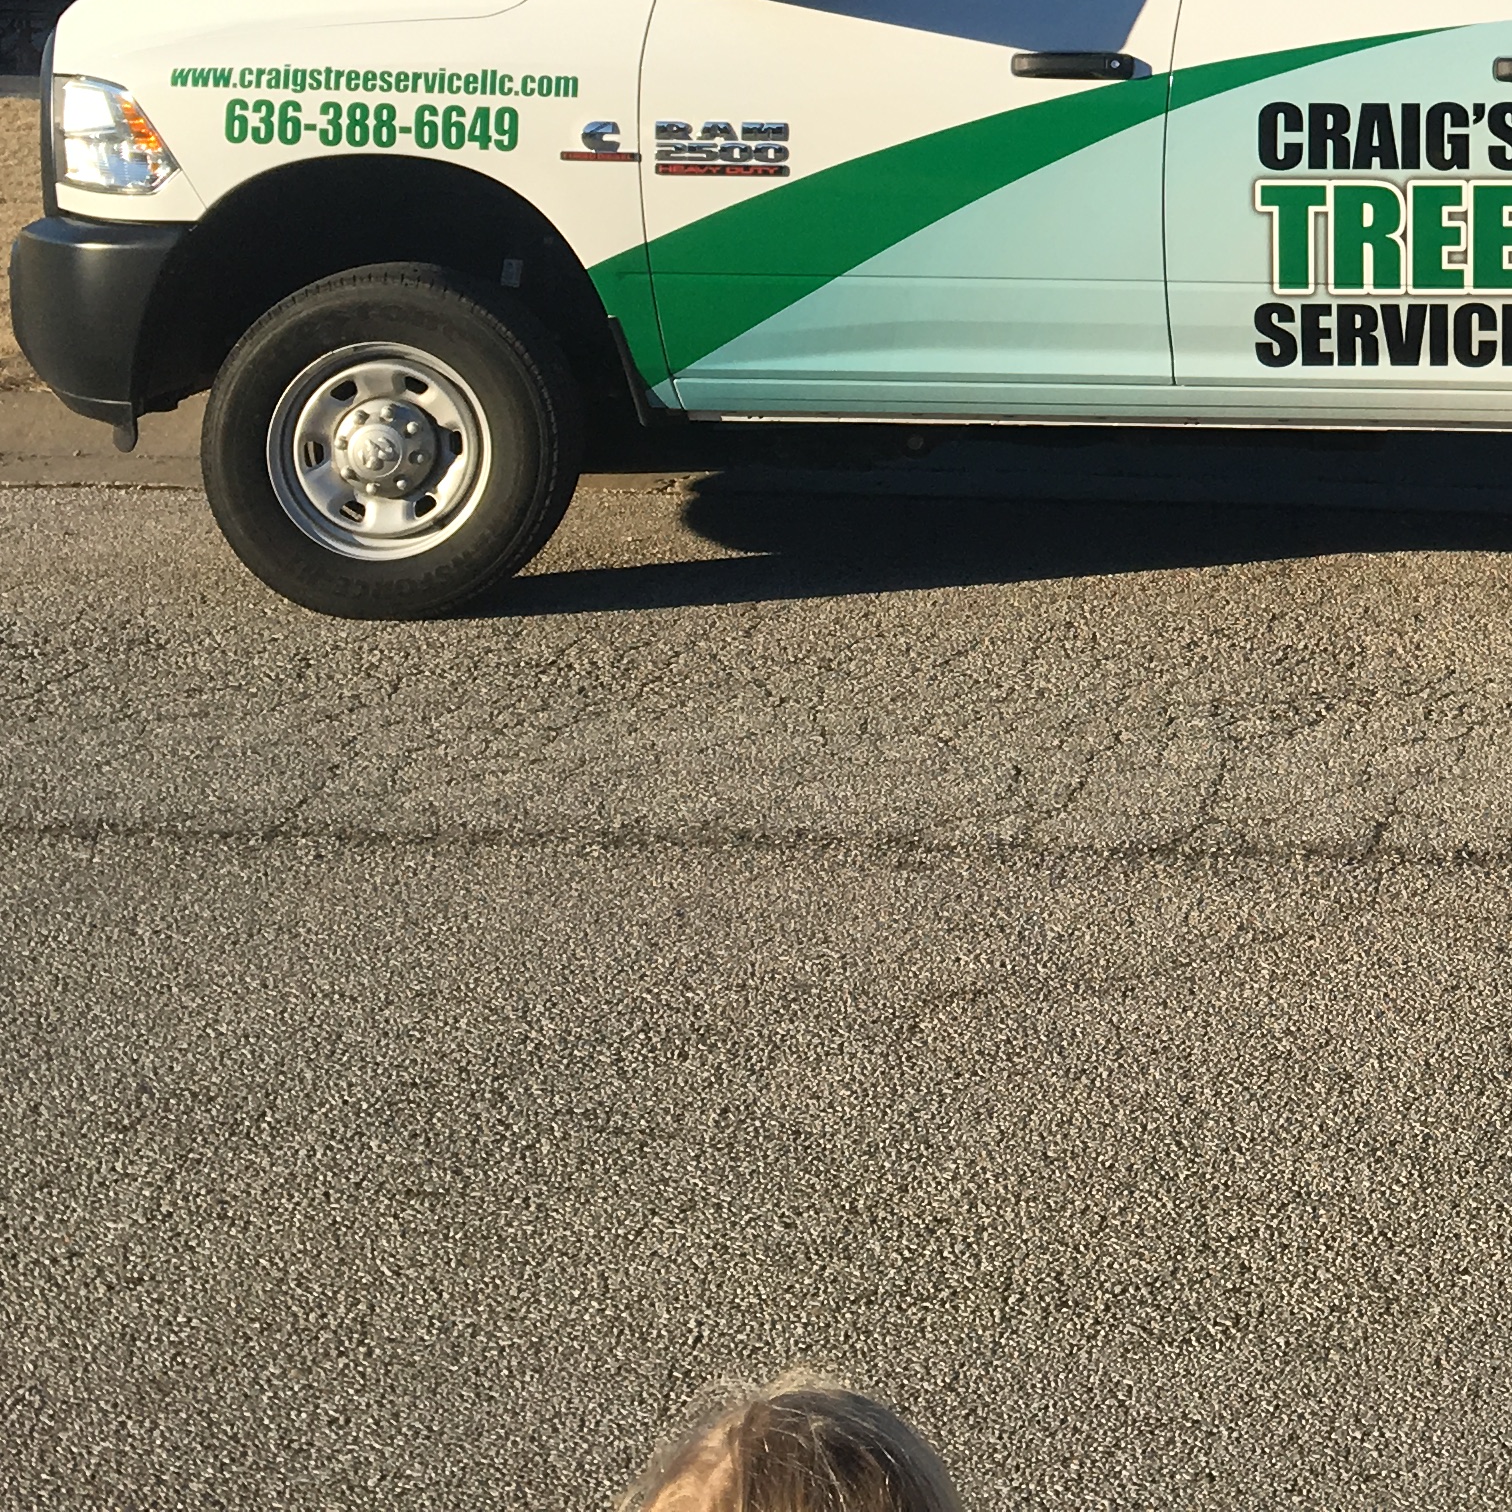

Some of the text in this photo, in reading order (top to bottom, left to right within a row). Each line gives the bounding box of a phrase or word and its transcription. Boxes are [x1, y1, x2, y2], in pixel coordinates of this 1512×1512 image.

[170, 64, 579, 99] www.craigstreeservicellc.com
[224, 97, 520, 153] 636-388-6649
[655, 120, 790, 142] RAM
[655, 142, 790, 163] 2500
[658, 165, 779, 176] HEAVY DUTY
